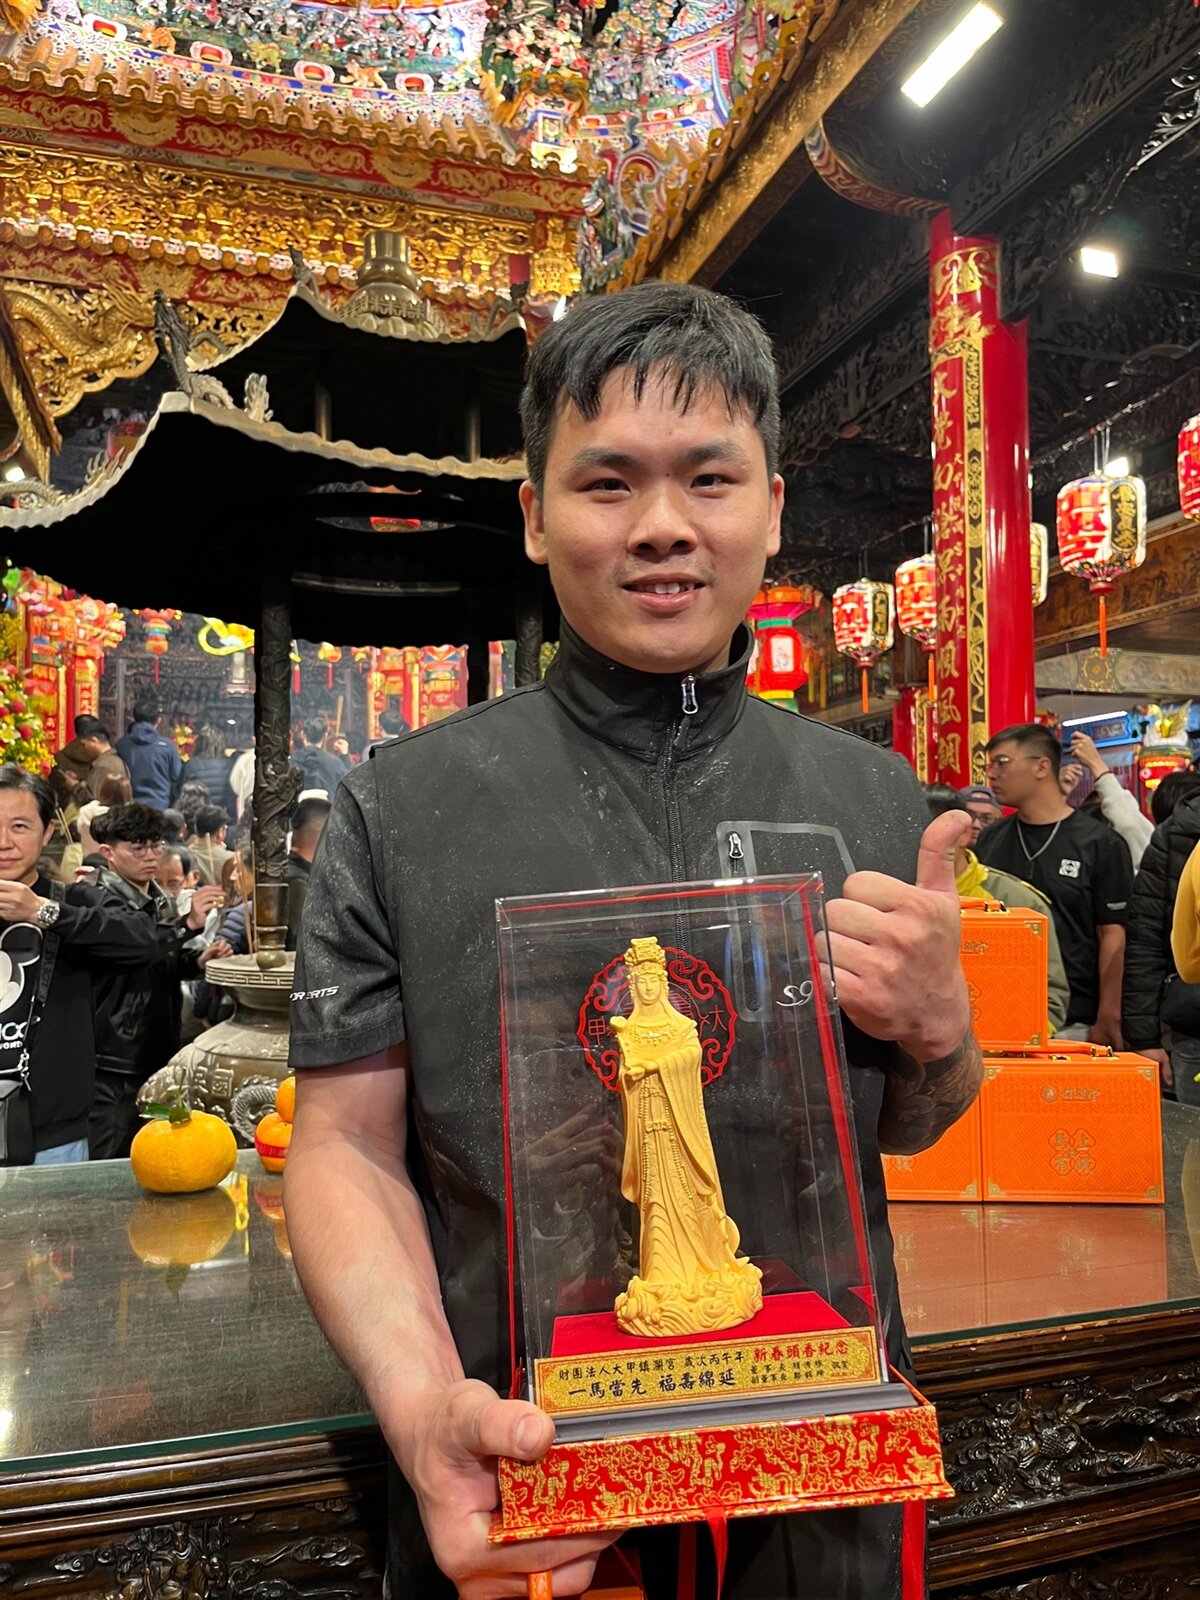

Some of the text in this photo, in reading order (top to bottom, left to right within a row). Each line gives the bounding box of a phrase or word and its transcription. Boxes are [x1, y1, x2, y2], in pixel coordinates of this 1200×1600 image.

[587, 1015, 606, 1046] 甲
[708, 1004, 728, 1033] 大
[558, 1351, 746, 1381] 財團法人大甲鎮瀾宮 歲次丙午年
[753, 1339, 849, 1363] 新春頭香紀念
[568, 1368, 736, 1399] 一馬當先 福壽綿延
